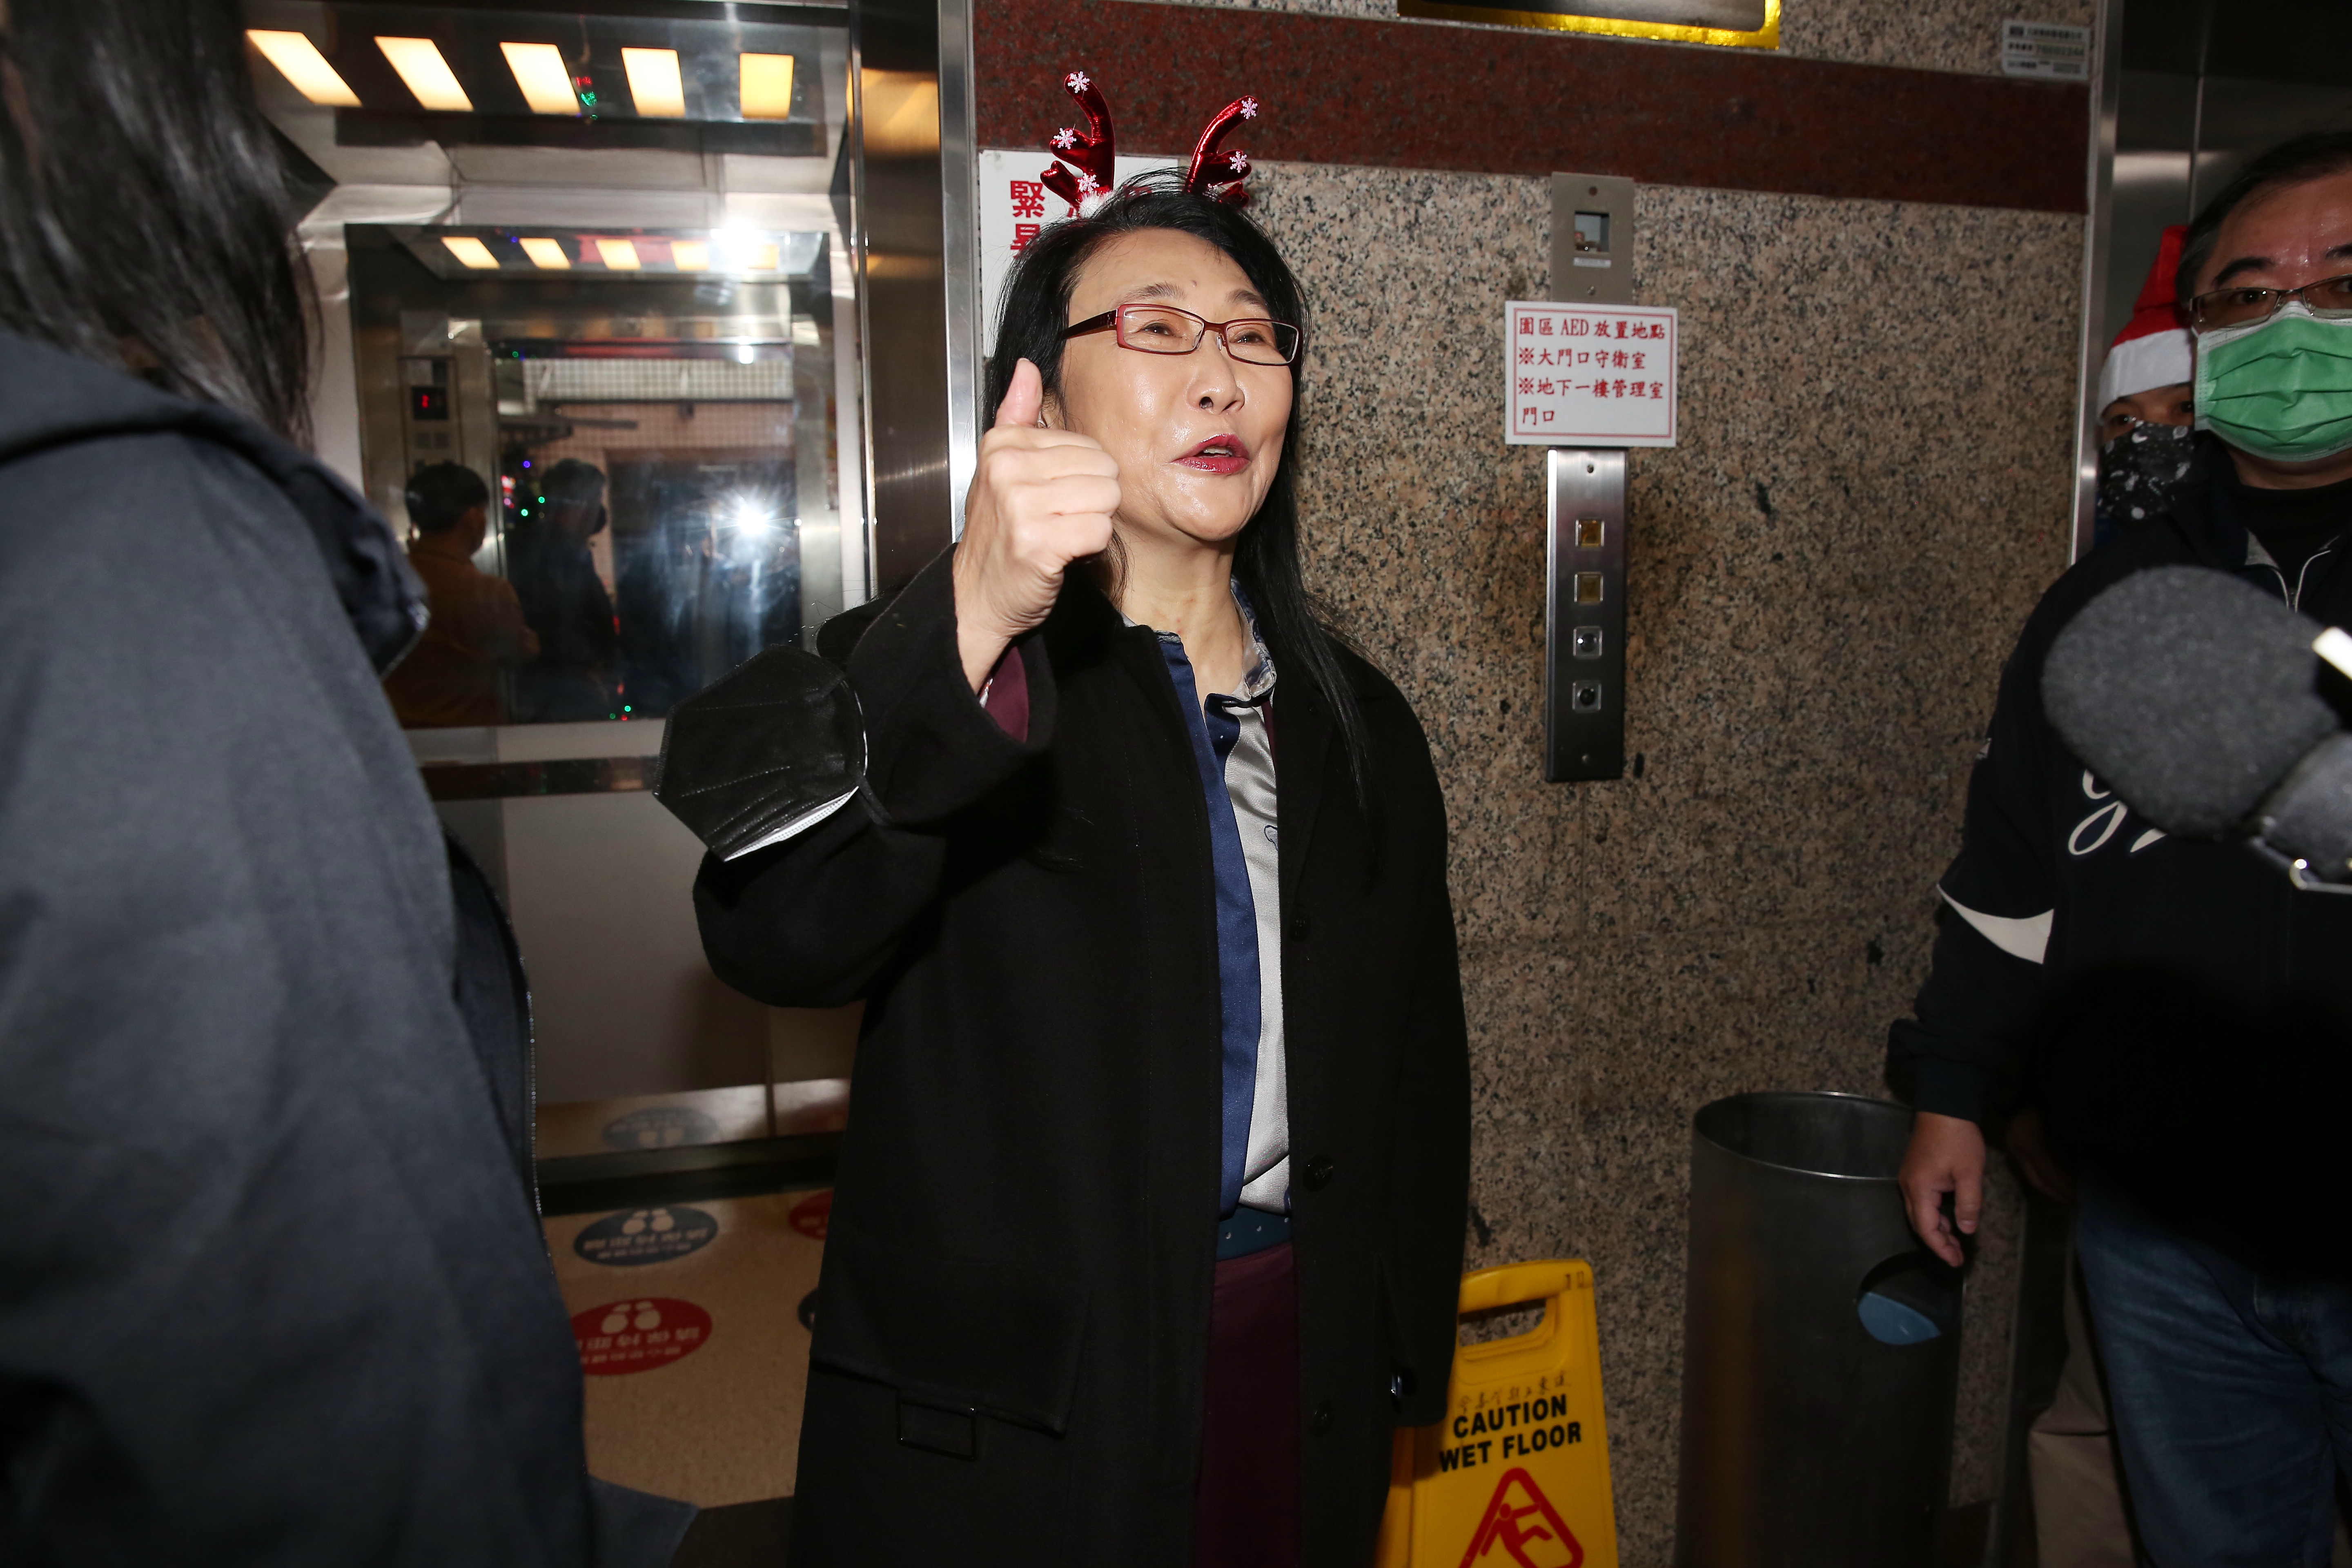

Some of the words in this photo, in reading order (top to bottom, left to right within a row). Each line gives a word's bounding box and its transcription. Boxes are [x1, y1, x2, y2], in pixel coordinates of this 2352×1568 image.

[1561, 318, 1589, 336] AED
[1594, 320, 1665, 339] 放置地點
[1523, 407, 1555, 425] 門口
[1454, 1394, 1566, 1438] CAUTION
[1440, 1440, 1492, 1472] WET
[1503, 1421, 1581, 1459] FLOOR
